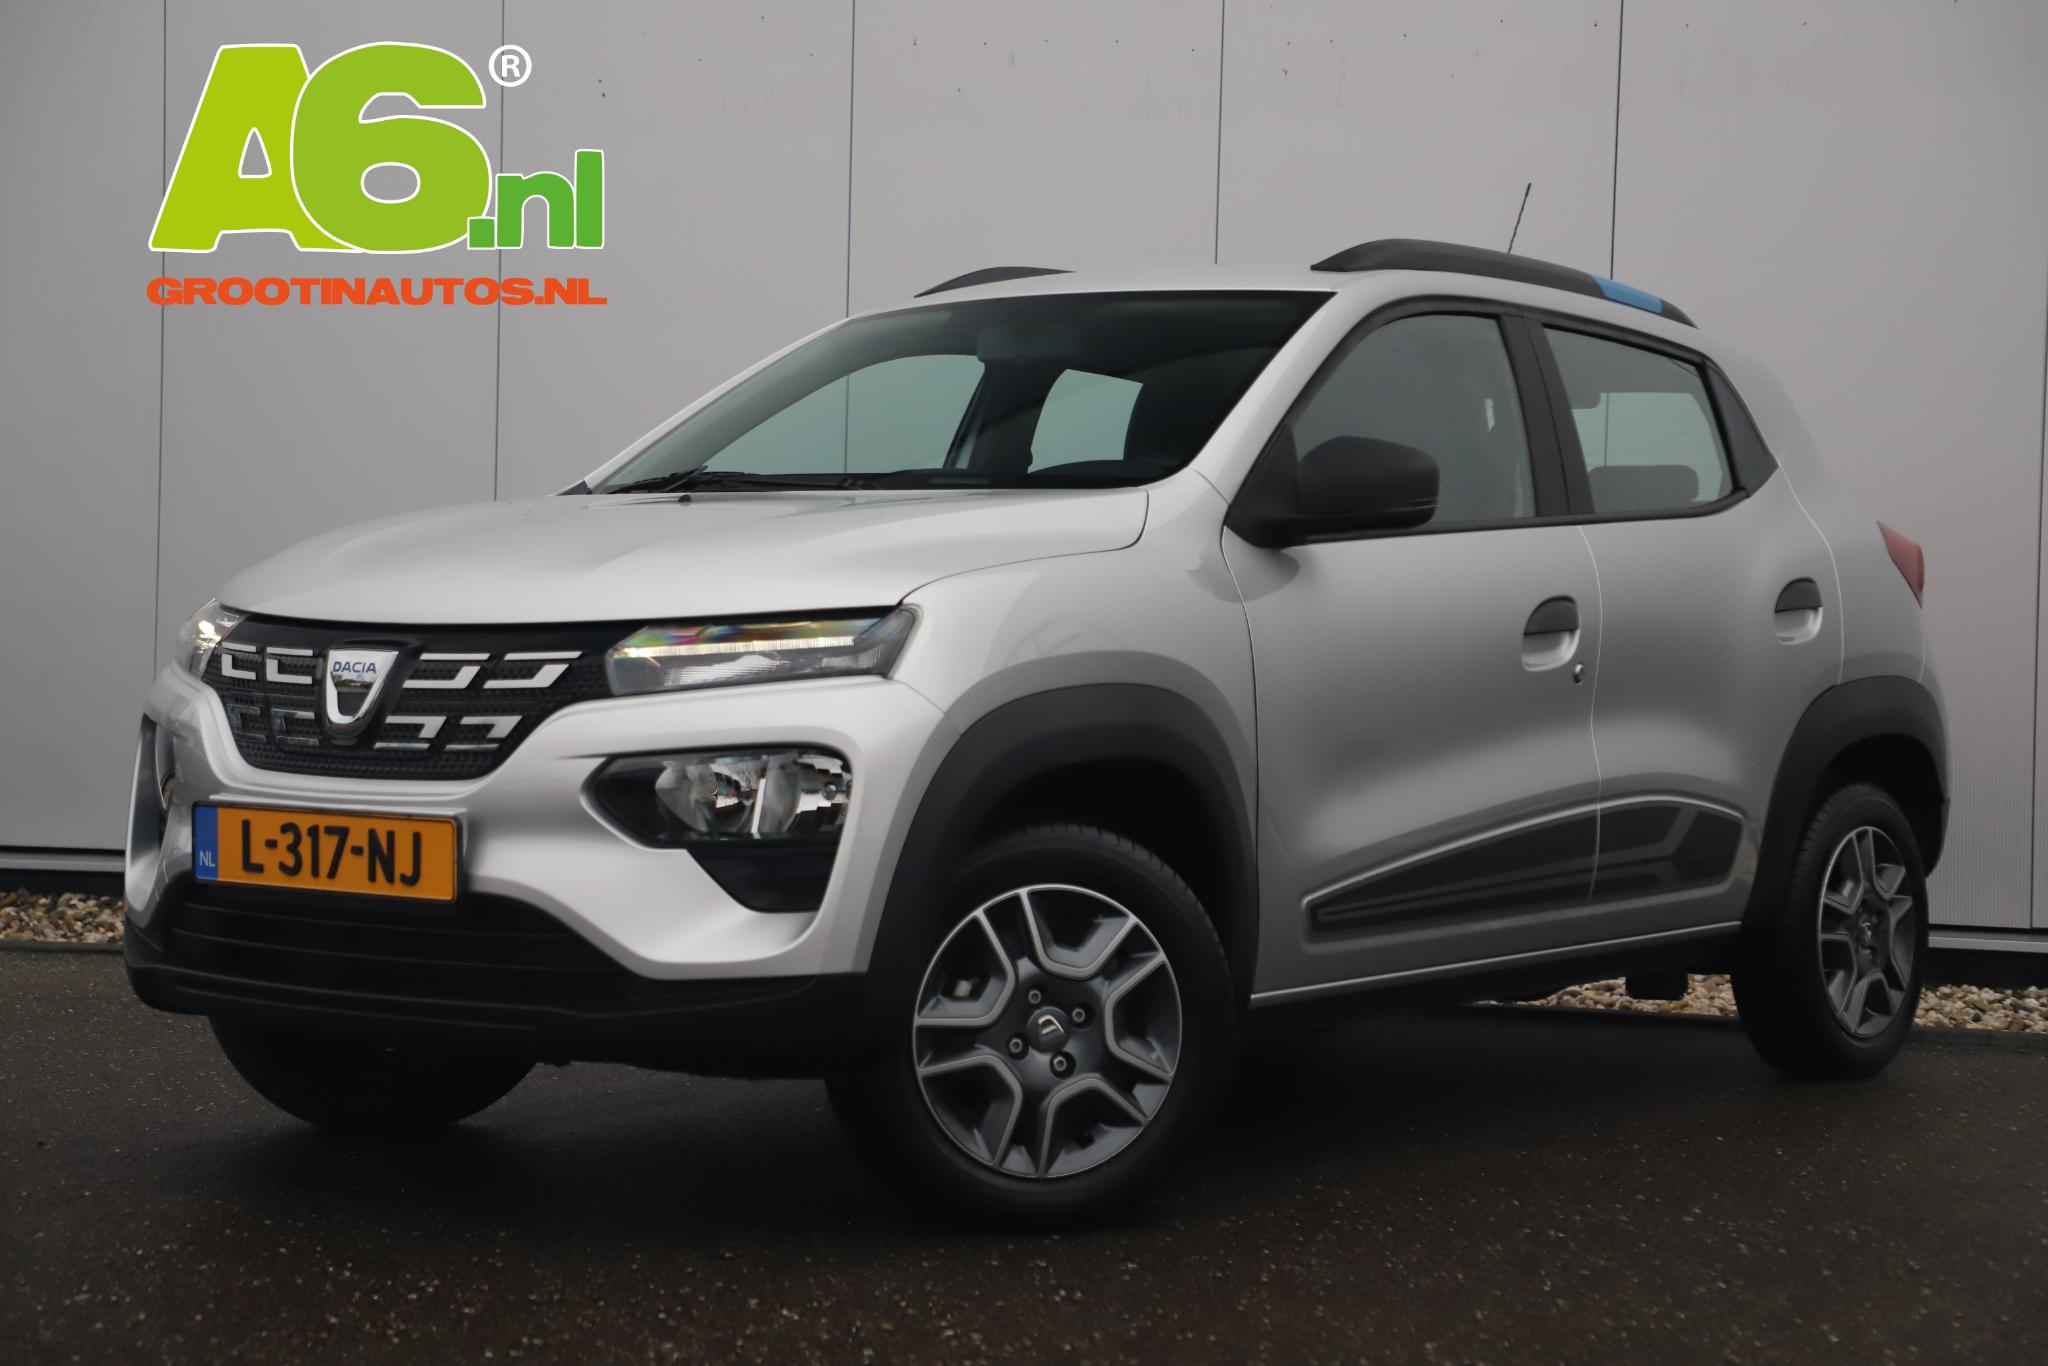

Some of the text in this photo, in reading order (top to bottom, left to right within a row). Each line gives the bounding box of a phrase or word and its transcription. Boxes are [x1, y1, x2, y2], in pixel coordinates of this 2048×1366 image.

[332, 661, 377, 674] DACIA
[199, 851, 216, 868] NL
[241, 819, 422, 887] L-317-NJ
